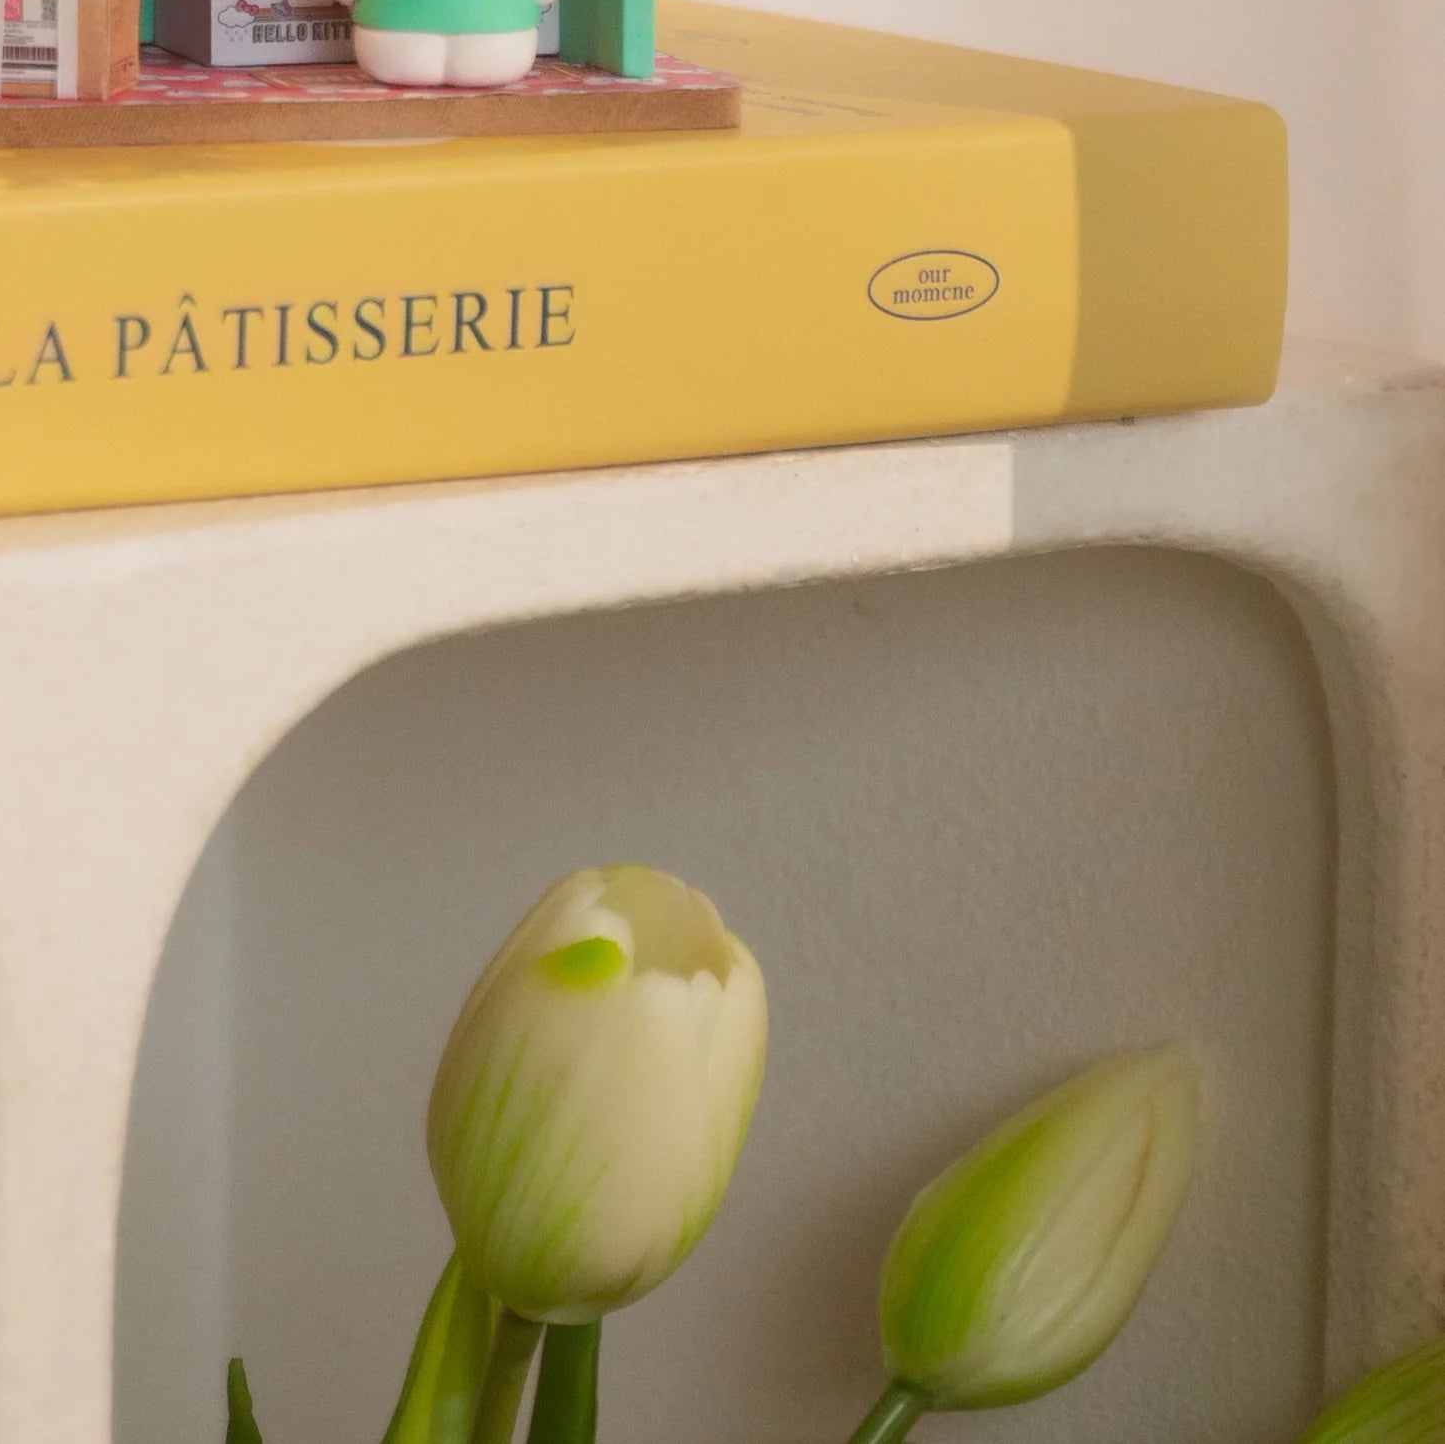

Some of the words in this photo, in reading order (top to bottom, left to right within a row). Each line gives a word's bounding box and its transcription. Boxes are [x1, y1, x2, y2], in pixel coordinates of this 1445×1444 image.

[252, 23, 308, 44] HELLO
[312, 21, 354, 41] KITT
[918, 268, 951, 284] our
[110, 284, 577, 380] PÂTISSERIE
